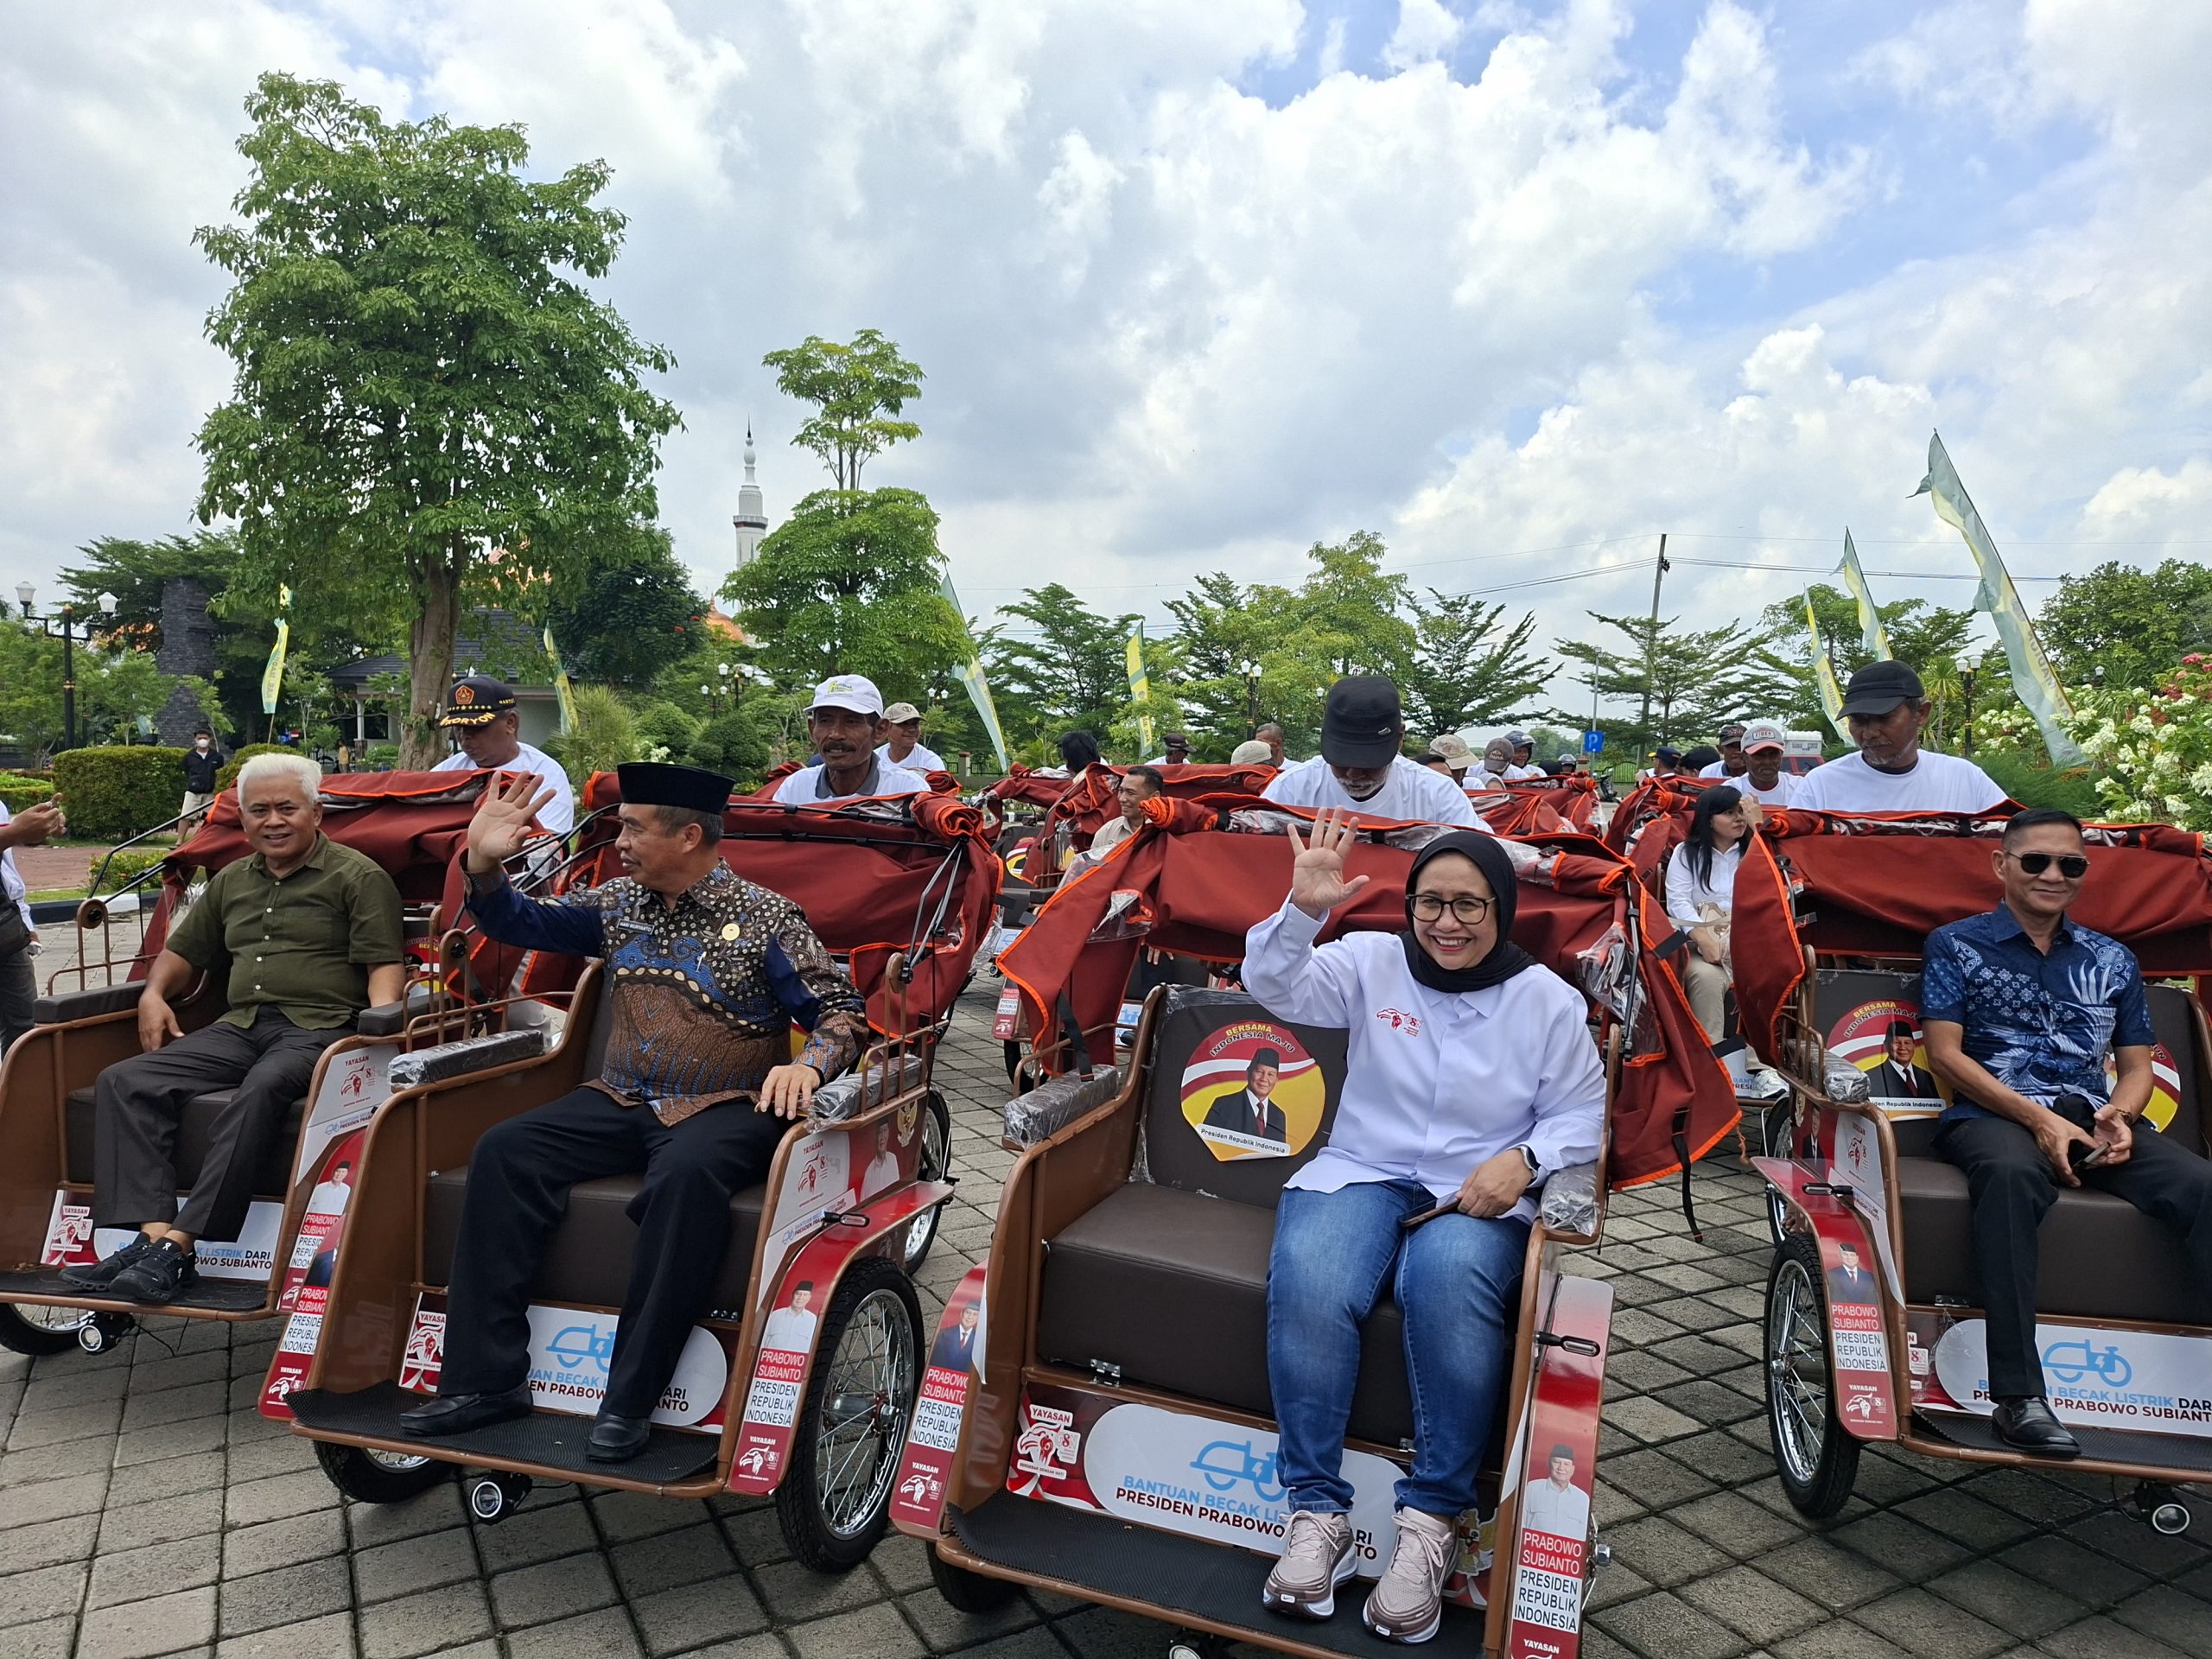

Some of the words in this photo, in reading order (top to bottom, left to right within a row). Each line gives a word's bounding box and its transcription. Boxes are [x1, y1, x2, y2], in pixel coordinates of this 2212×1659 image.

[1589, 734, 1599, 748] P
[1853, 1001, 1897, 1018] BERSAMA
[1225, 1024, 1272, 1037] BERSAMA
[1843, 1008, 1891, 1038] INDONESIA
[1210, 1031, 1264, 1057] INDONESIA
[1266, 1033, 1295, 1052] MAJU
[345, 1055, 370, 1066] YAYASAN
[804, 1140, 823, 1154] YAYASAN
[1201, 1128, 1228, 1140] Presiden
[1229, 1135, 1255, 1147] Republik
[1255, 1141, 1286, 1154] Indonesia
[305, 1215, 339, 1225] PRABOWO
[302, 1225, 330, 1236] SUBIANT
[299, 1236, 323, 1246] PRESID
[204, 1248, 244, 1258] LISTRIK
[245, 1250, 271, 1261] DARI
[219, 1258, 272, 1270] SUBIANTO
[296, 1300, 326, 1313] SUBIANT
[1831, 1305, 1878, 1319] PRABOWO
[292, 1314, 322, 1328] PRESIDE
[420, 1313, 445, 1323] YAYASA
[1833, 1318, 1879, 1331] SUBIANTO
[288, 1328, 318, 1340] REPUBLI
[1835, 1332, 1881, 1345] PRESIDEN
[281, 1340, 315, 1353] INDONESI
[1837, 1344, 1883, 1357] REPUBLIK
[760, 1350, 805, 1367] PRABOWO
[1836, 1357, 1886, 1371] INDONESIA
[280, 1366, 303, 1375] YAYASAN
[758, 1363, 802, 1381] SUBIANTO
[556, 1372, 600, 1389] BECAK
[550, 1382, 606, 1400] PRABOW
[663, 1386, 687, 1400] ARI
[754, 1381, 798, 1397] PRESIDEN
[657, 1399, 690, 1412] ANTO
[750, 1395, 795, 1411] REPUBLIK
[2058, 1386, 2111, 1402] BECAK
[2114, 1392, 2174, 1408] LISTRIK
[2178, 1397, 2212, 1411] DAR
[919, 1401, 962, 1420] PRESIDEN
[1033, 1408, 1071, 1423] YAYASAN
[2054, 1397, 2138, 1415] PRABOWO
[2142, 1406, 2212, 1422] SUBIANT
[745, 1409, 792, 1426] INDONESIA
[916, 1415, 959, 1434] REPUBLIK
[749, 1435, 776, 1446] YAYASAN
[910, 1431, 957, 1450] INDONESIA
[912, 1461, 939, 1474] YAYASAN
[1123, 1475, 1200, 1503] BANTUAN
[1205, 1494, 1260, 1518] BECAK
[1116, 1487, 1194, 1517] PRESIDEN
[1198, 1506, 1286, 1538] PRABOWO
[1356, 1529, 1372, 1545] RI
[1523, 1531, 1582, 1557] PRABOWO
[1522, 1549, 1580, 1575] SUBIANTO
[1521, 1569, 1578, 1595] PRESIDEN
[1518, 1586, 1577, 1613] REPUBLIK
[1514, 1604, 1577, 1632] INDONESIA
[1523, 1638, 1560, 1654] YAYASAN
